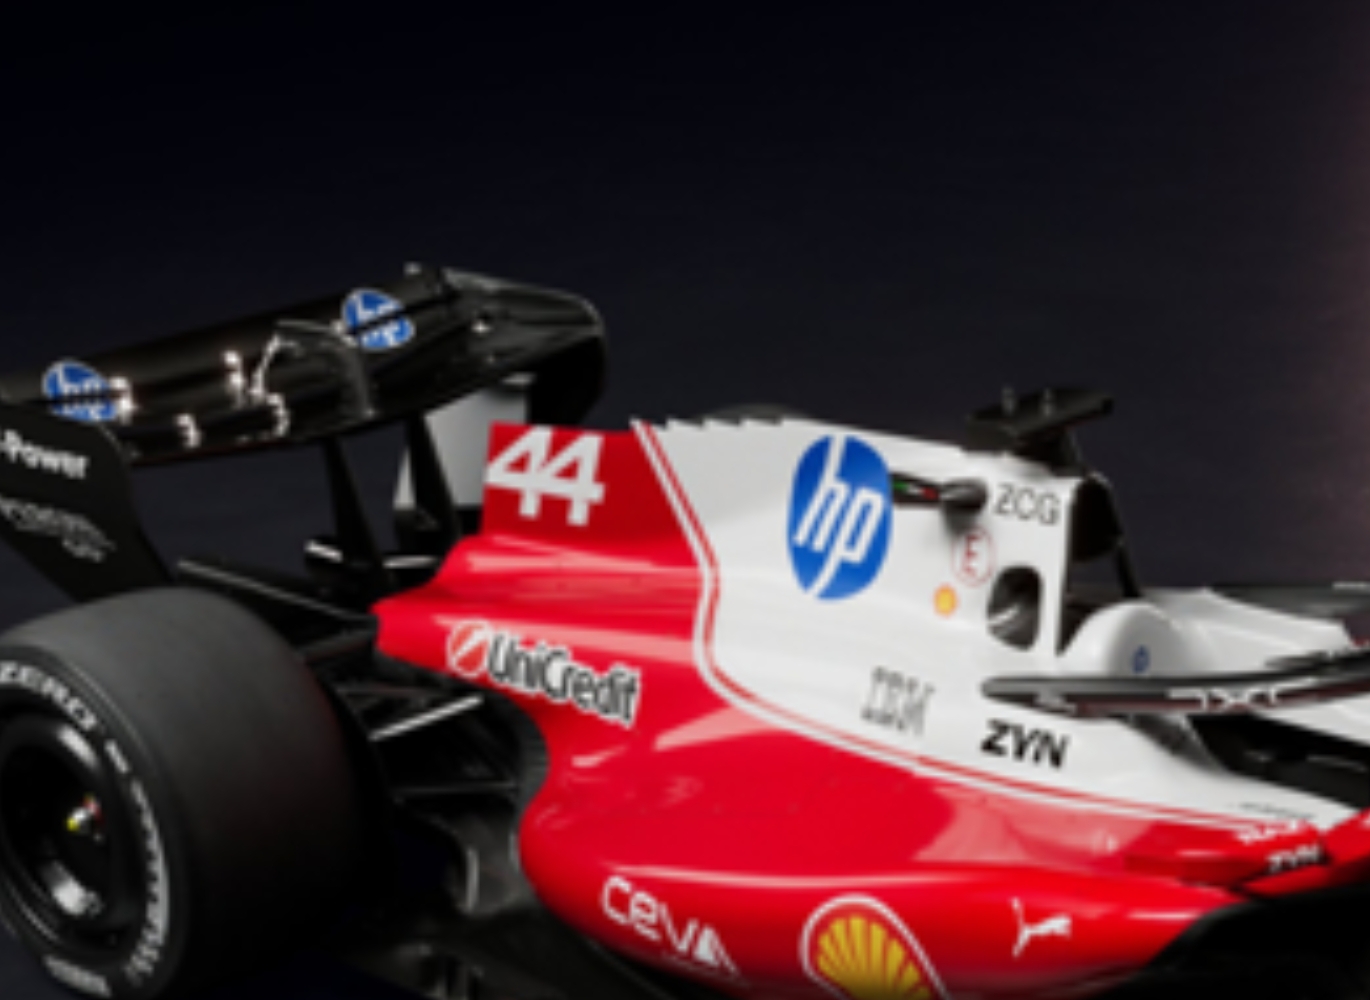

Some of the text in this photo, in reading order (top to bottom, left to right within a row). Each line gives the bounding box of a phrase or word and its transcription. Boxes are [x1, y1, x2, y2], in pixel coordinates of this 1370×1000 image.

[484, 425, 605, 526] 44
[789, 432, 891, 600] hp
[486, 631, 642, 731] UniCredit
[980, 718, 1070, 769] ZYN
